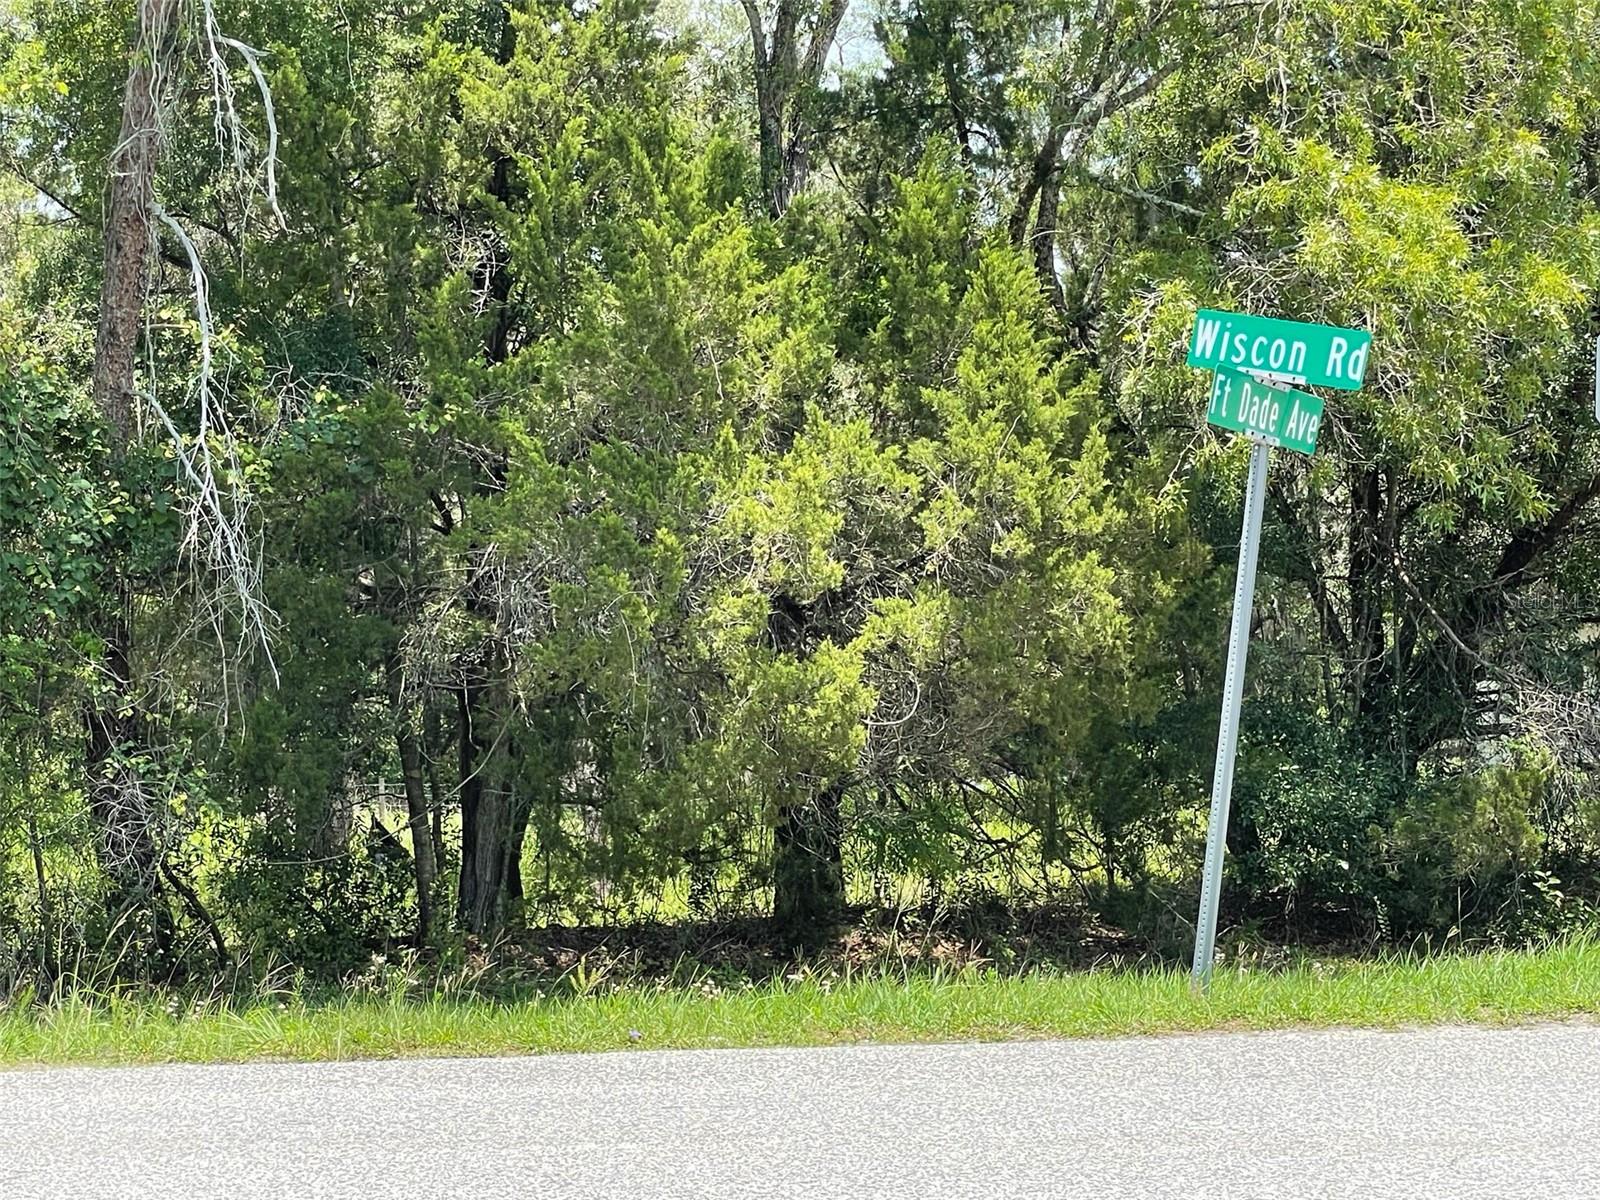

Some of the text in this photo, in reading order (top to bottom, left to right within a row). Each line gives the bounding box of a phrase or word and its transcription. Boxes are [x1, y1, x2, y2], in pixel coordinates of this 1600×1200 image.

[1195, 318, 1369, 383] Wiscon Rd
[1210, 373, 1318, 444] Ft Dade Ave
